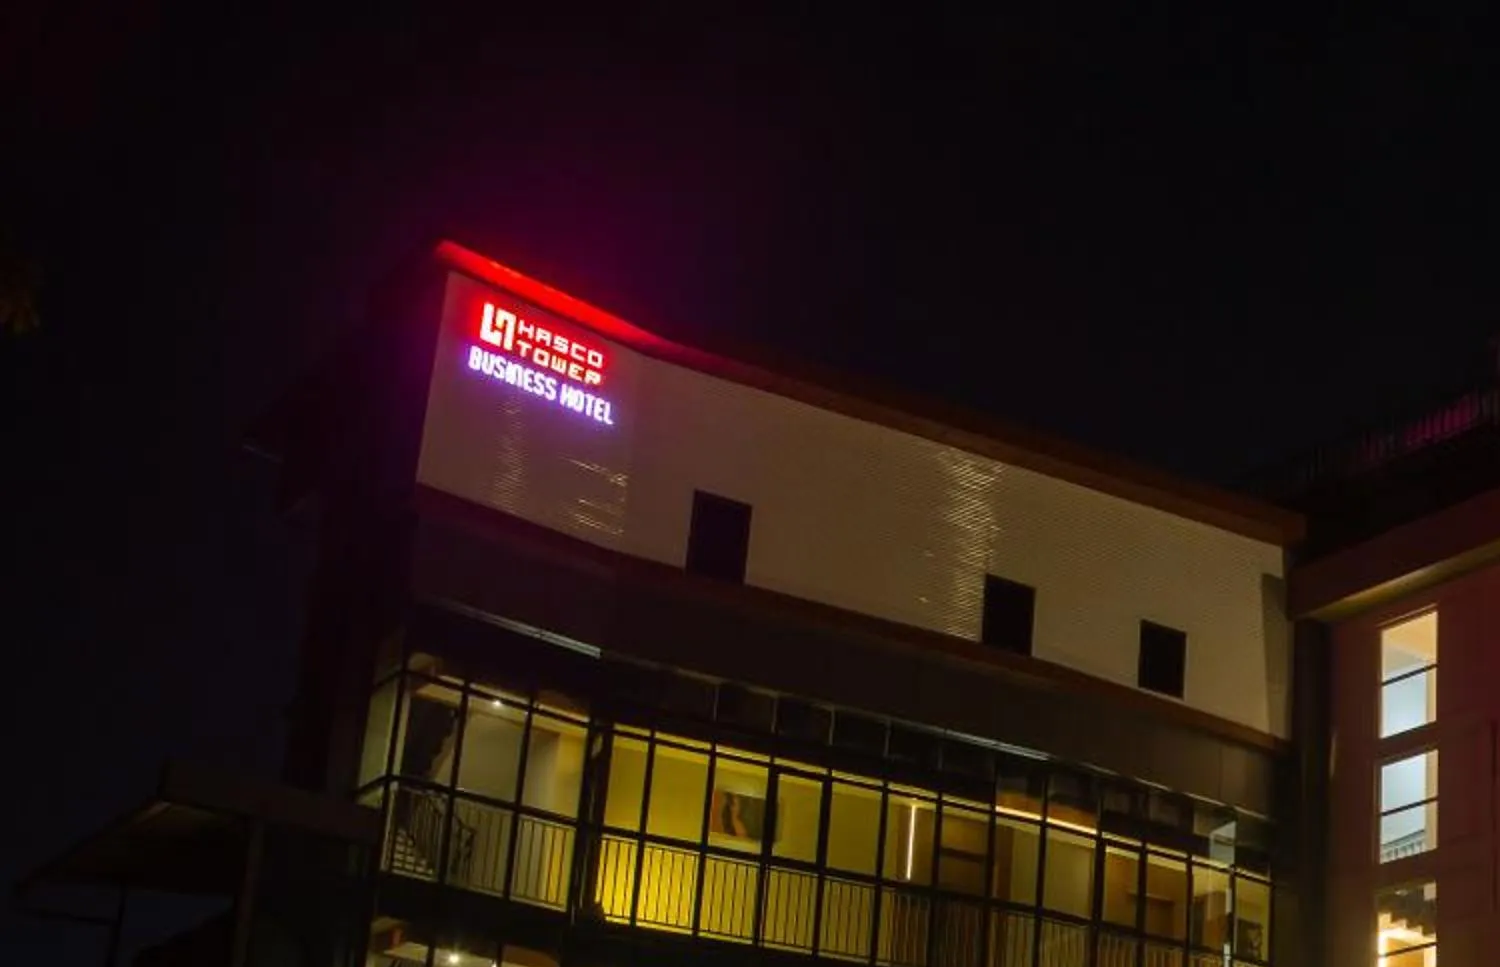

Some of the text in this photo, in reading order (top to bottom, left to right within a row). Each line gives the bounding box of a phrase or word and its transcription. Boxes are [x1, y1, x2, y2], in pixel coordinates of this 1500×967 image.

[516, 340, 602, 385] TOWER
[517, 320, 603, 368] HASCO
[468, 345, 614, 425] BUSINESS HOTEL
